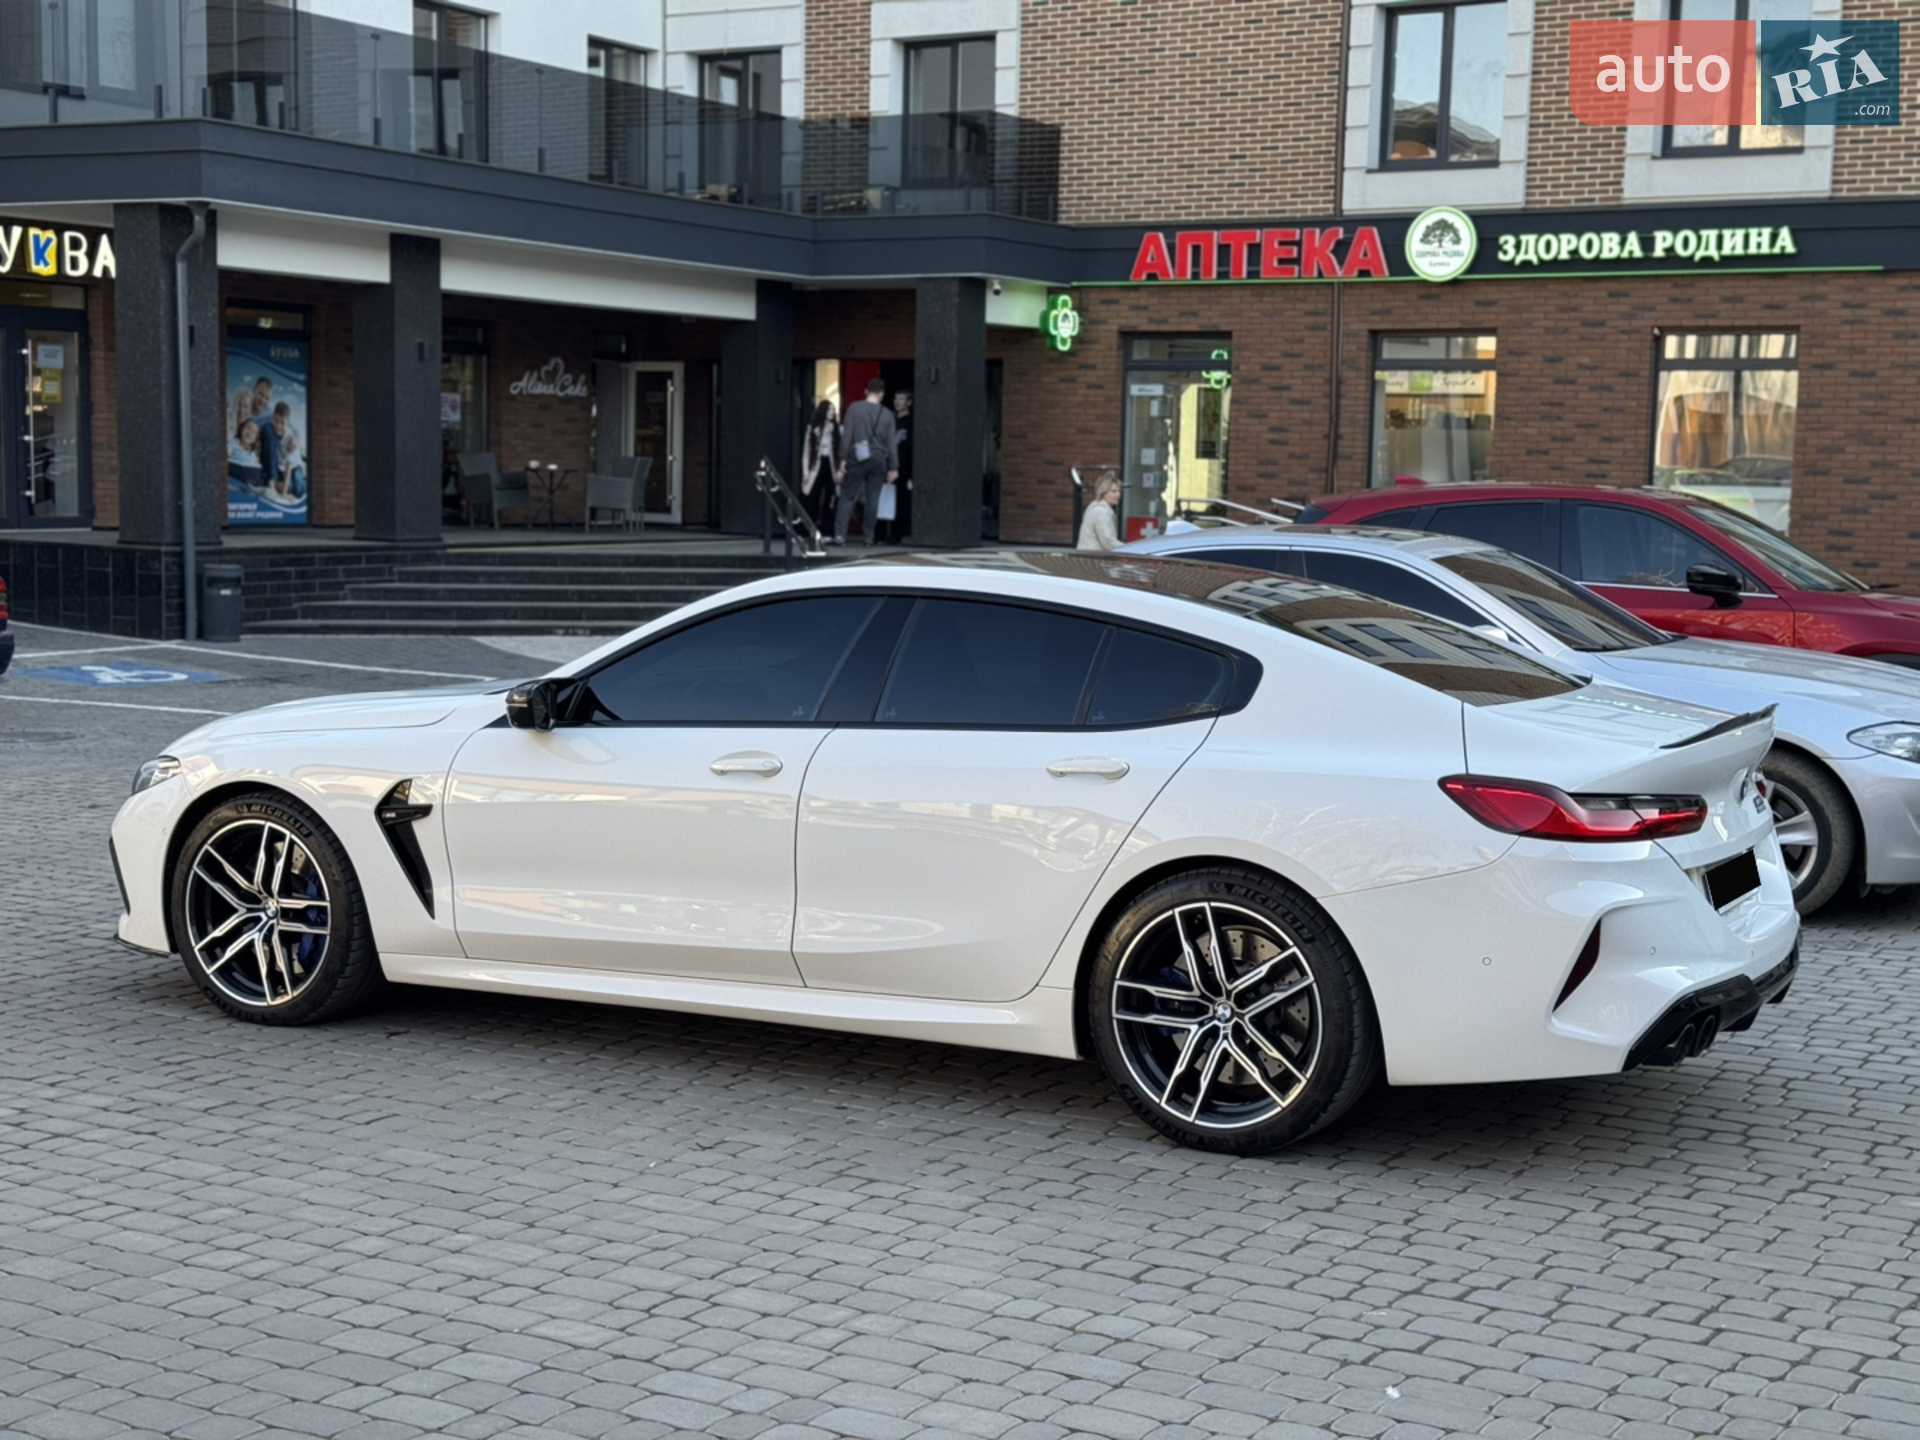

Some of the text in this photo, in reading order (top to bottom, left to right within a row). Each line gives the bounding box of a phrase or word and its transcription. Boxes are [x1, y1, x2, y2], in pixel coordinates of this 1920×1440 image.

[1130, 226, 1390, 281] АПТЕКА
[1498, 226, 1797, 266] ЗДОРОВА РОДИНА
[1230, 883, 1313, 941] MICHELIN
